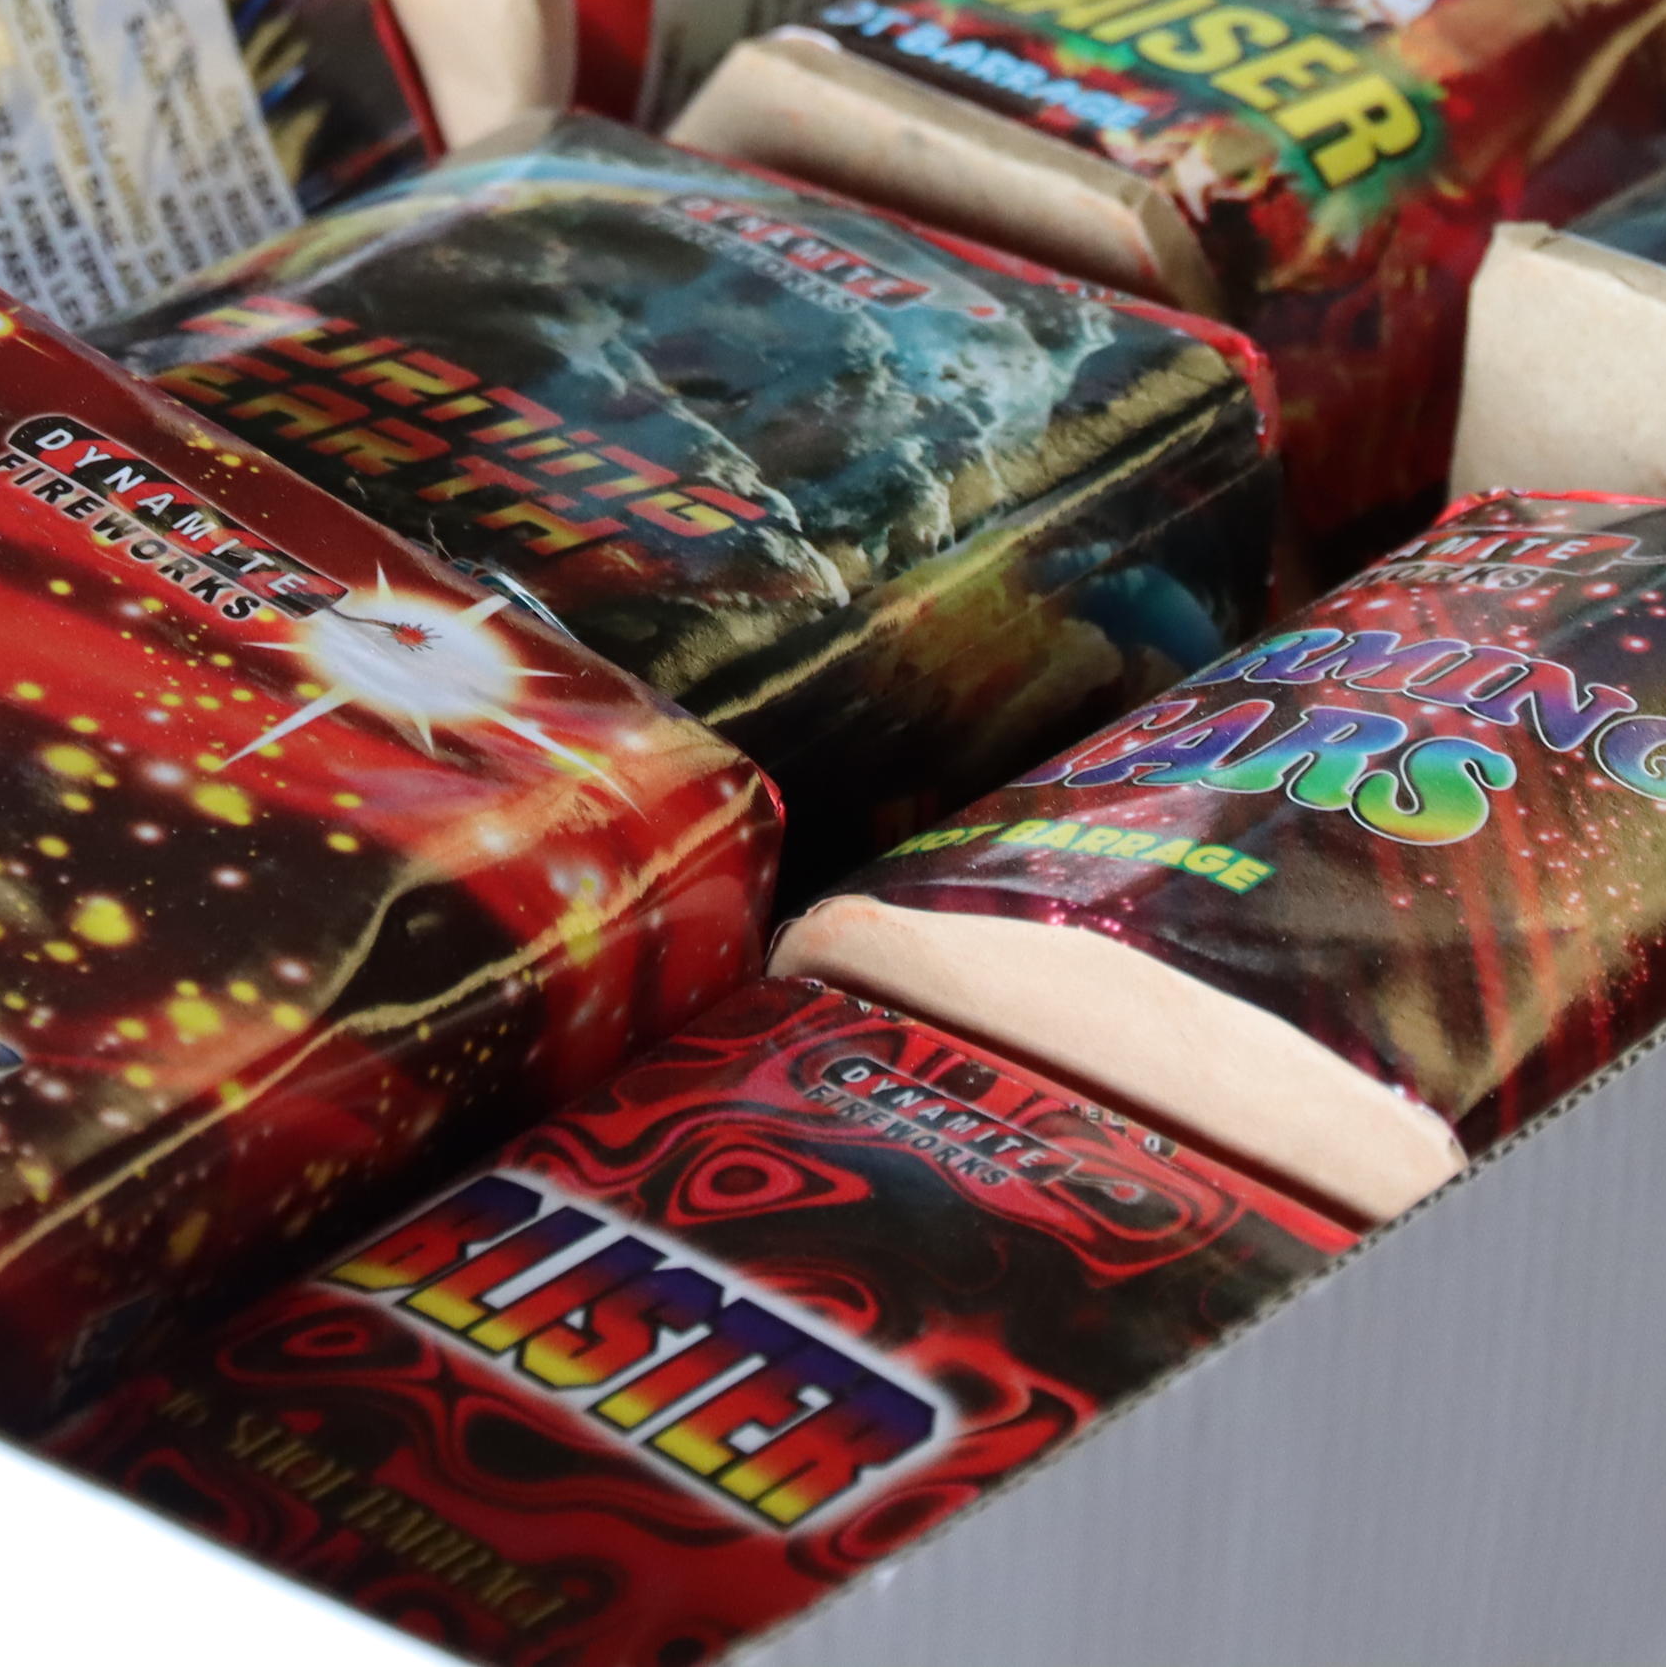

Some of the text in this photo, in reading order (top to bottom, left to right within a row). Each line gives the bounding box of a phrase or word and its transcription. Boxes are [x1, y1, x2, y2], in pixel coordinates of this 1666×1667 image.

[896, 23, 1148, 130] BARRAGE
[145, 350, 628, 559] EARTH
[179, 295, 768, 538] BURNING
[35, 427, 309, 596] DYNAMITE
[990, 818, 1277, 895] BARRAGE
[803, 1082, 1010, 1188] FIREWORKS
[840, 1064, 1051, 1170] DYNAMITE
[325, 1173, 938, 1532] BLISTER
